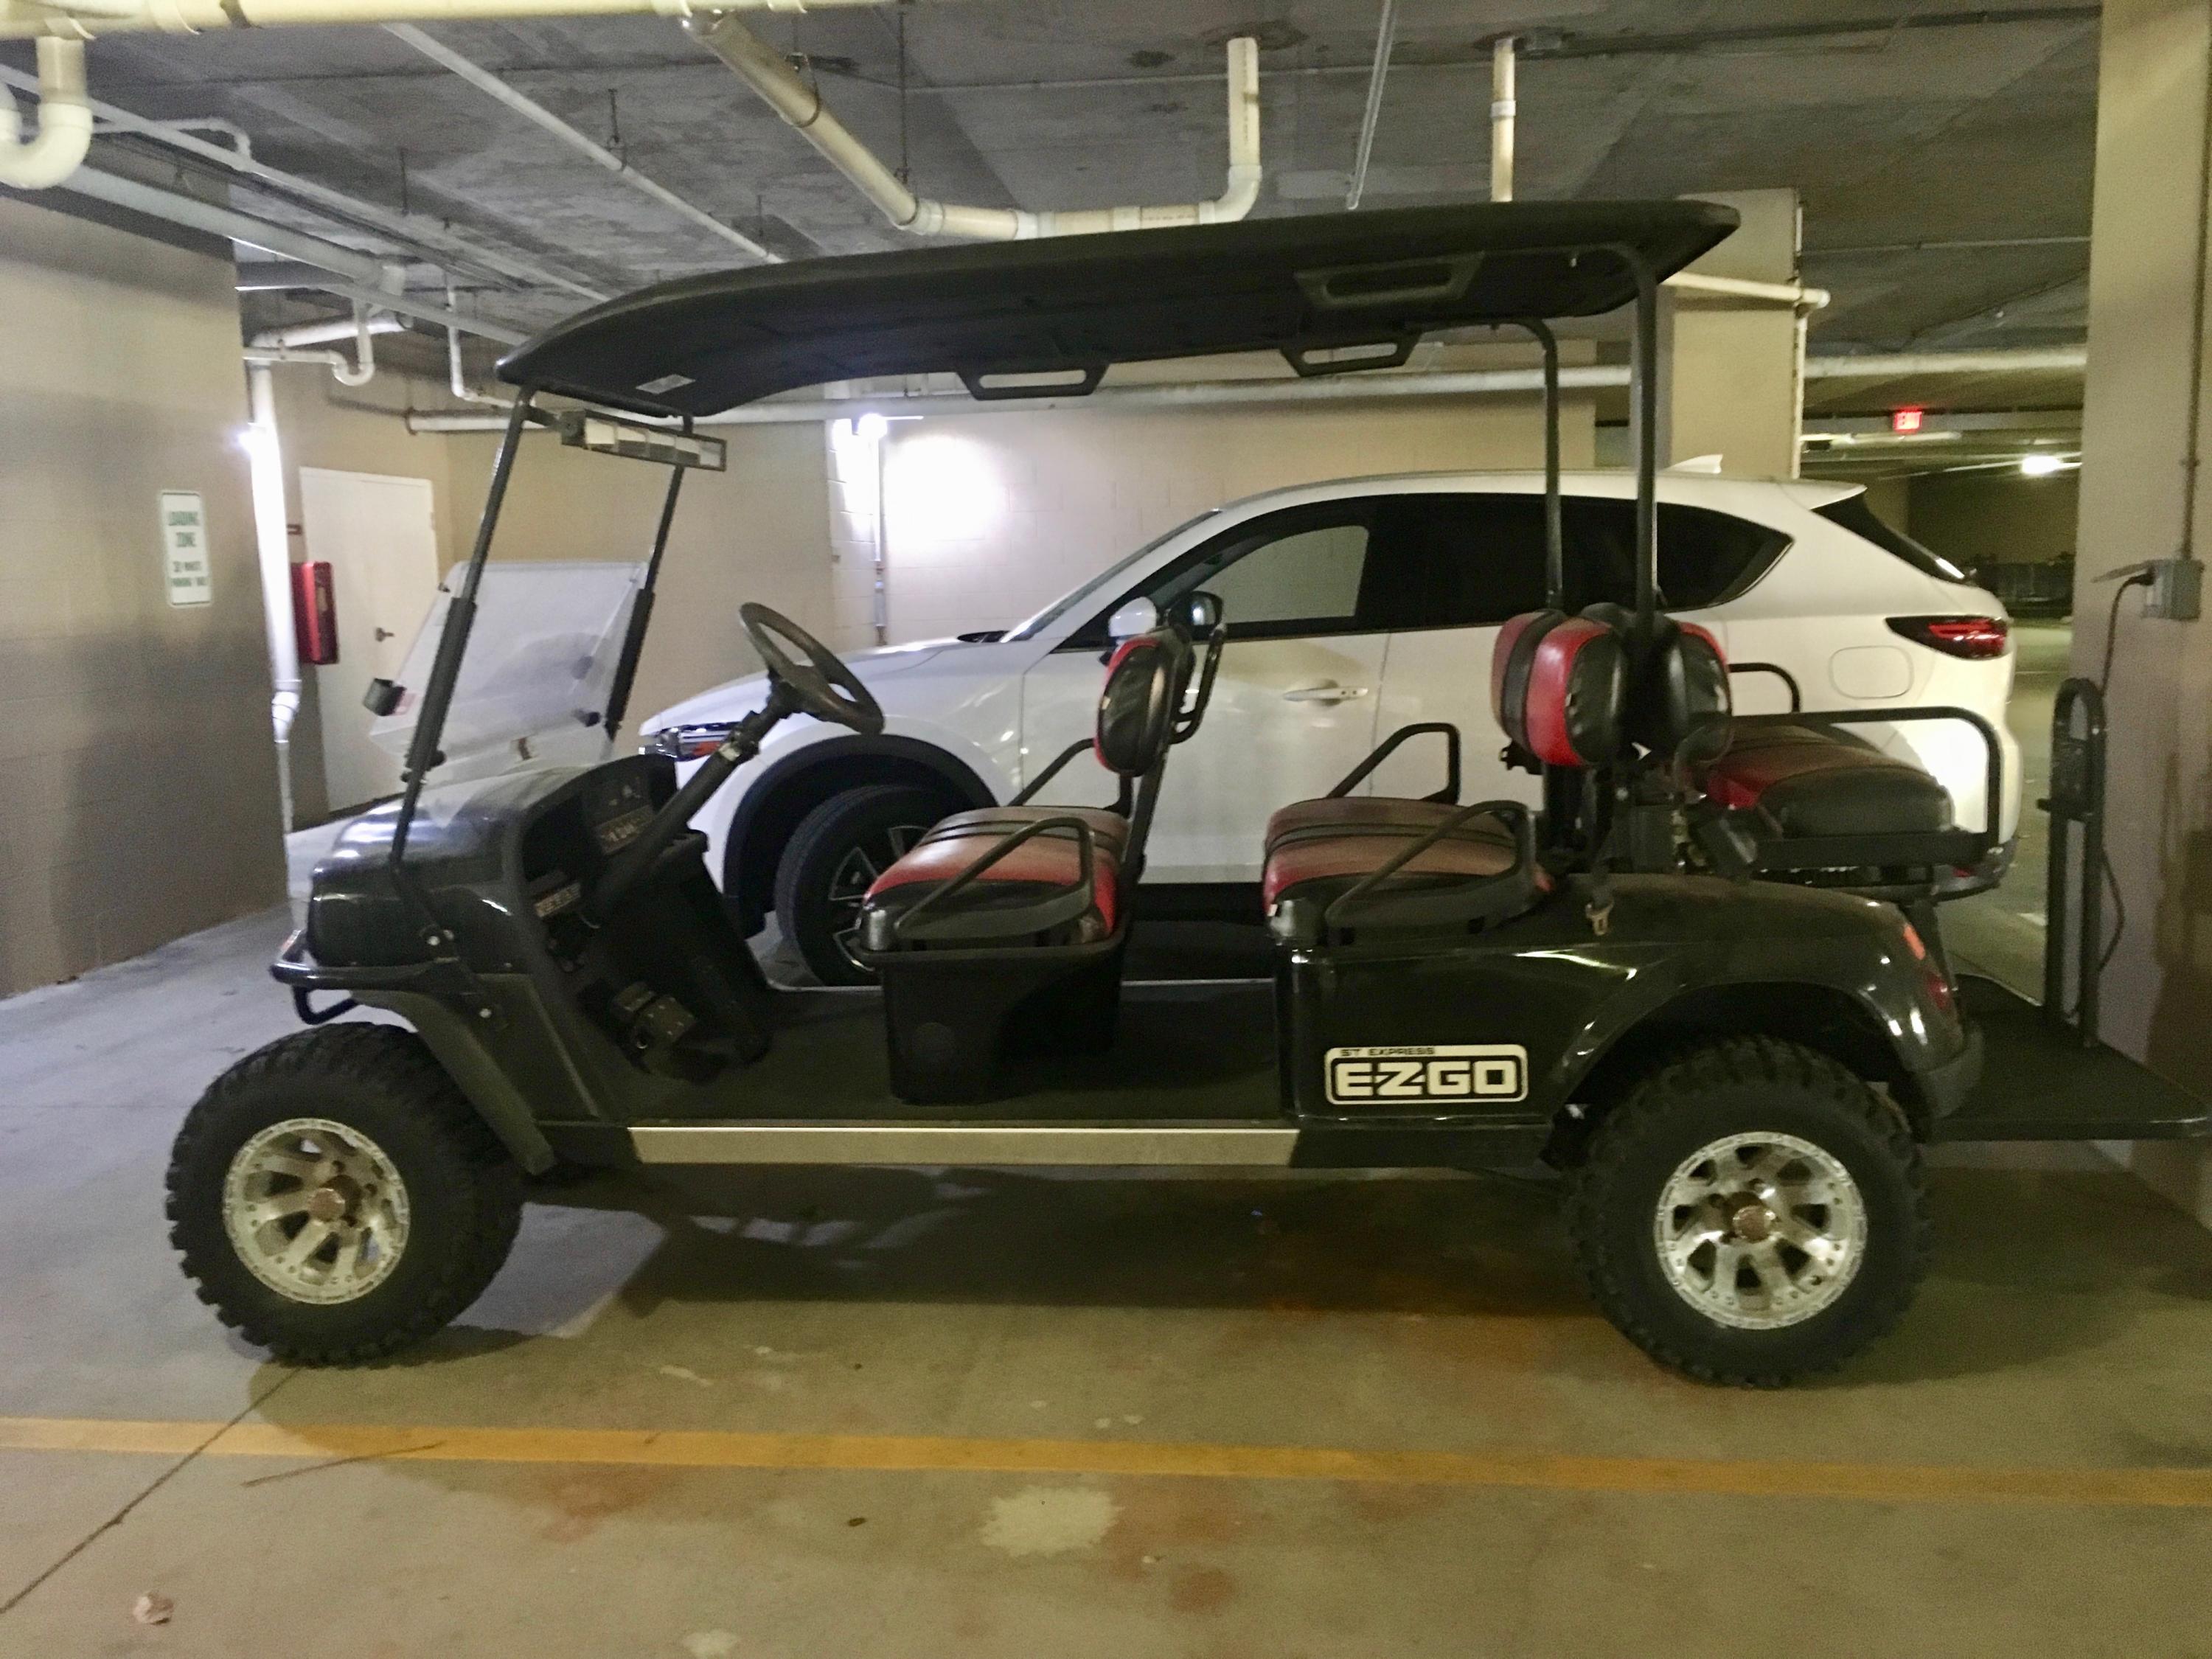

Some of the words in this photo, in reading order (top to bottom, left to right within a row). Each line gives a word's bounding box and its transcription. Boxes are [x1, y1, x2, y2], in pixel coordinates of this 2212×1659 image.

[1340, 1048, 1360, 1057] ST
[1368, 1047, 1435, 1056] EXPRESS
[1335, 1060, 1517, 1096] EZGO
